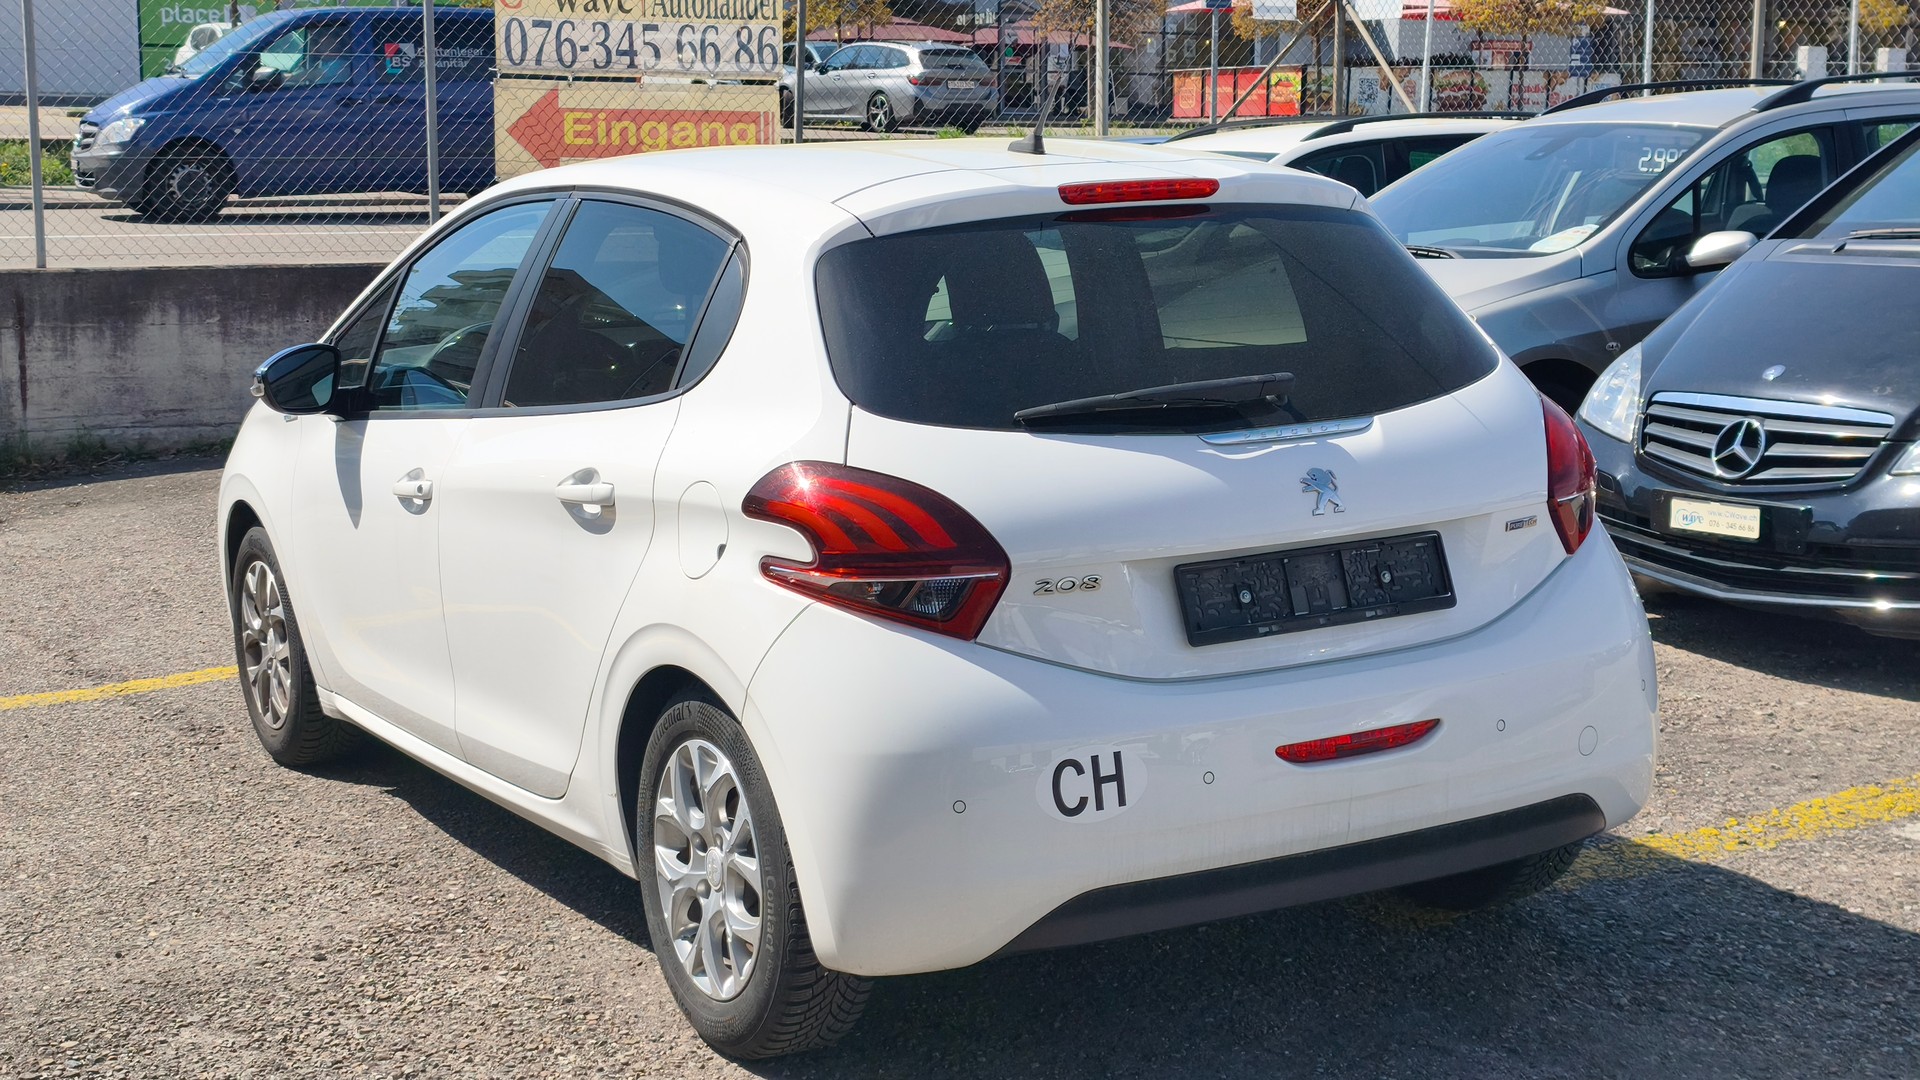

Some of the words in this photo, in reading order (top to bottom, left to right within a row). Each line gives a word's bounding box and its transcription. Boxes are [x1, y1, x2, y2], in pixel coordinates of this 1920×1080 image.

[504, 17, 661, 70] 076-345
[676, 24, 721, 72] 66
[735, 26, 778, 73] 86
[392, 57, 411, 68] BS
[432, 58, 468, 68] anitär
[564, 112, 757, 151] Eingang
[1243, 423, 1341, 440] PEUGEOT
[1033, 574, 1102, 596] 208
[1052, 751, 1126, 817] CH
